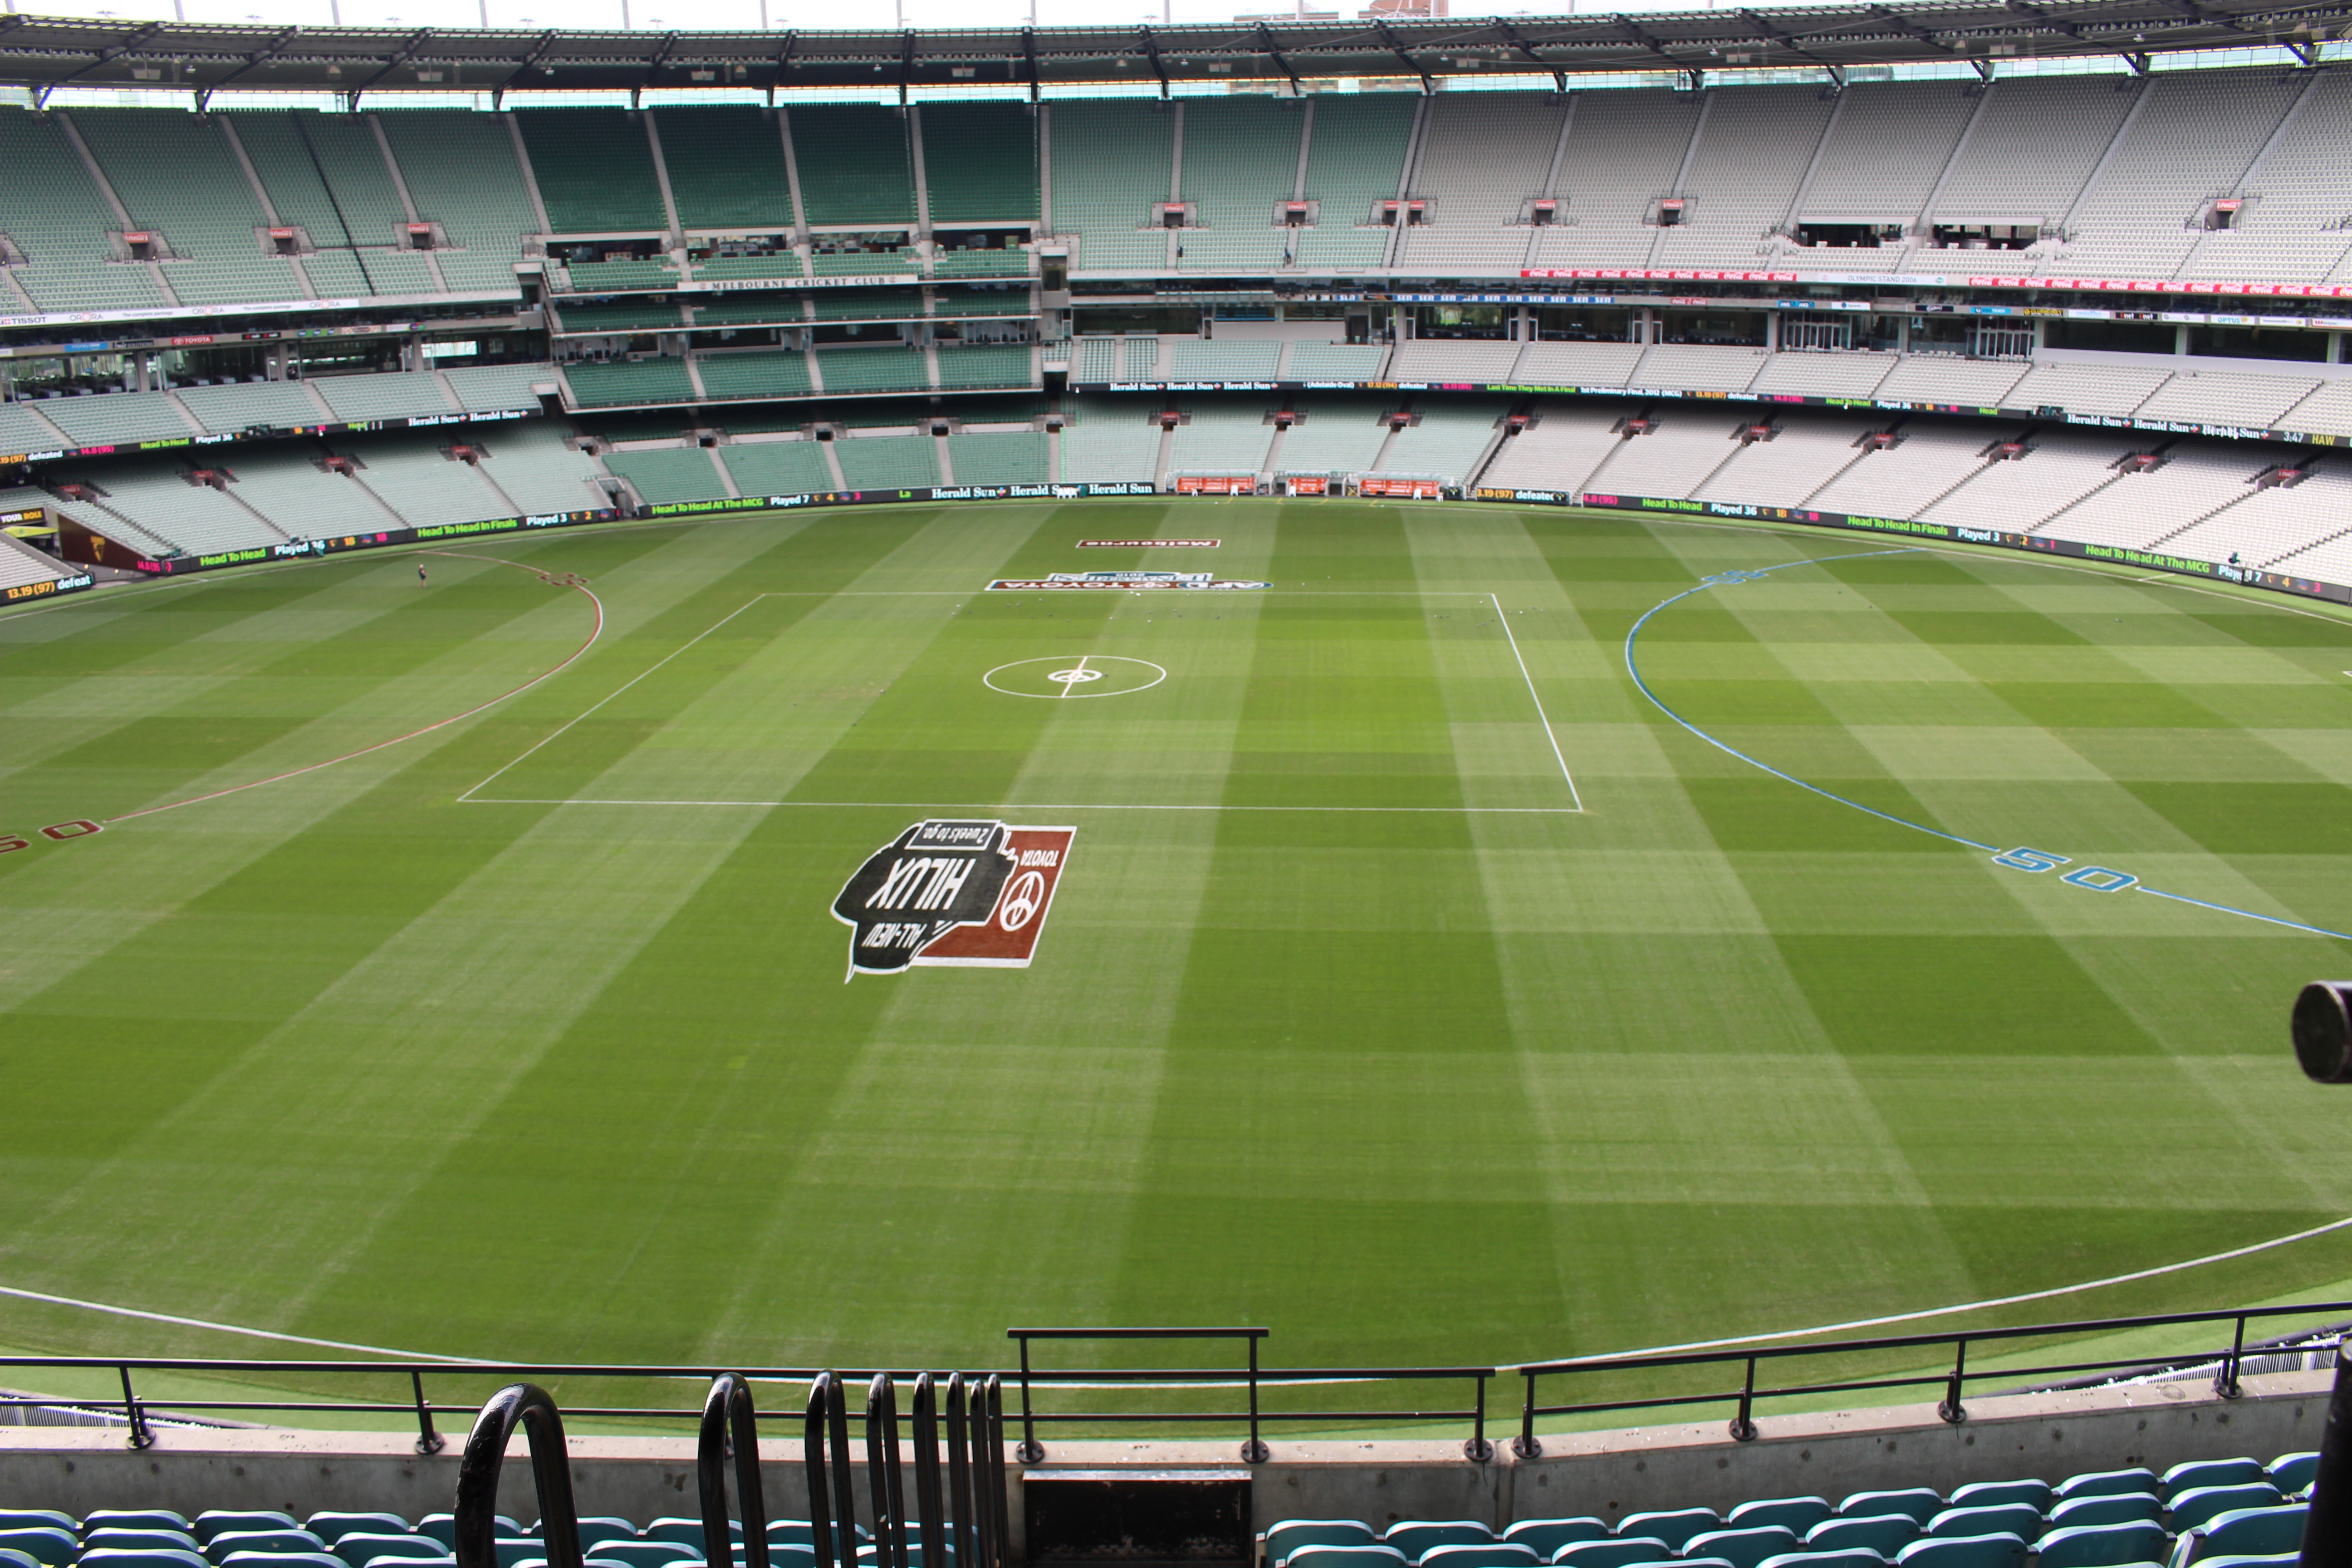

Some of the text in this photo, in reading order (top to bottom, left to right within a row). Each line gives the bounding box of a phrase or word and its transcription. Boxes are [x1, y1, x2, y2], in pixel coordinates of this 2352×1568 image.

[712, 276, 886, 289] MELBOURNE CRICKET CLUB
[11, 316, 47, 324] TISSOT
[1110, 382, 1157, 391] Herald Sun
[1166, 382, 1195, 391] Herald
[1224, 382, 1270, 390] Herald Sun
[1727, 392, 1758, 401] defeated
[1853, 399, 1871, 407] Head
[1877, 400, 1900, 410] Played
[408, 415, 459, 426] Herald Sun
[469, 410, 520, 421] Herald Sun
[2067, 413, 2122, 427] Herald Sun
[2134, 419, 2190, 433] Herald Sun
[2239, 426, 2260, 439] Sun
[2283, 431, 2304, 443] 3:47
[2312, 434, 2336, 446] HAW
[28, 450, 64, 461] defeated
[140, 440, 161, 450] Head
[170, 438, 190, 446] Head
[195, 434, 221, 444] Played
[899, 486, 996, 499] La Herald Sun
[1010, 485, 1049, 496] Herald
[1089, 483, 1152, 495] Herald Sun
[1494, 489, 1514, 500] (97)
[652, 491, 861, 515] Head To Head At The MCG Played 7 4 3
[1642, 498, 1666, 509] Head
[1667, 500, 1678, 509] To
[1679, 500, 1703, 512] Head
[1710, 503, 1742, 516] Played
[1744, 505, 1758, 516] 36
[0, 510, 43, 523] YOUR ROLE
[417, 511, 593, 538] Head To Head In Finals Played 3 2
[1847, 515, 1872, 528] Head
[1873, 518, 1884, 529] To
[1885, 519, 1910, 531] Head
[1911, 522, 1920, 532] In
[1921, 523, 1948, 536] Finals
[1957, 528, 1990, 542] Played
[1992, 532, 2000, 542] 3
[200, 551, 227, 567] Head
[228, 551, 240, 563] To
[240, 548, 266, 561] Head
[274, 541, 309, 557] Played
[343, 536, 356, 546] 18
[376, 532, 387, 542] 18
[2085, 544, 2112, 559] Head
[2113, 548, 2124, 560] To
[2126, 549, 2152, 564] Head
[2154, 552, 2165, 567] At
[2166, 554, 2185, 569] The
[2186, 558, 2210, 574] MCG
[2254, 571, 2262, 583] 7
[2282, 577, 2291, 588] 4
[2313, 582, 2322, 593] 3
[7, 574, 92, 599] 13.19 (97) defeat
[936, 828, 952, 842] to
[947, 828, 982, 843] weeks
[976, 828, 990, 844] 2
[1019, 850, 1061, 867] TOYOTA
[1990, 846, 2139, 893] 50
[865, 857, 976, 910] HILUX
[862, 923, 928, 948] ALL-NEW
